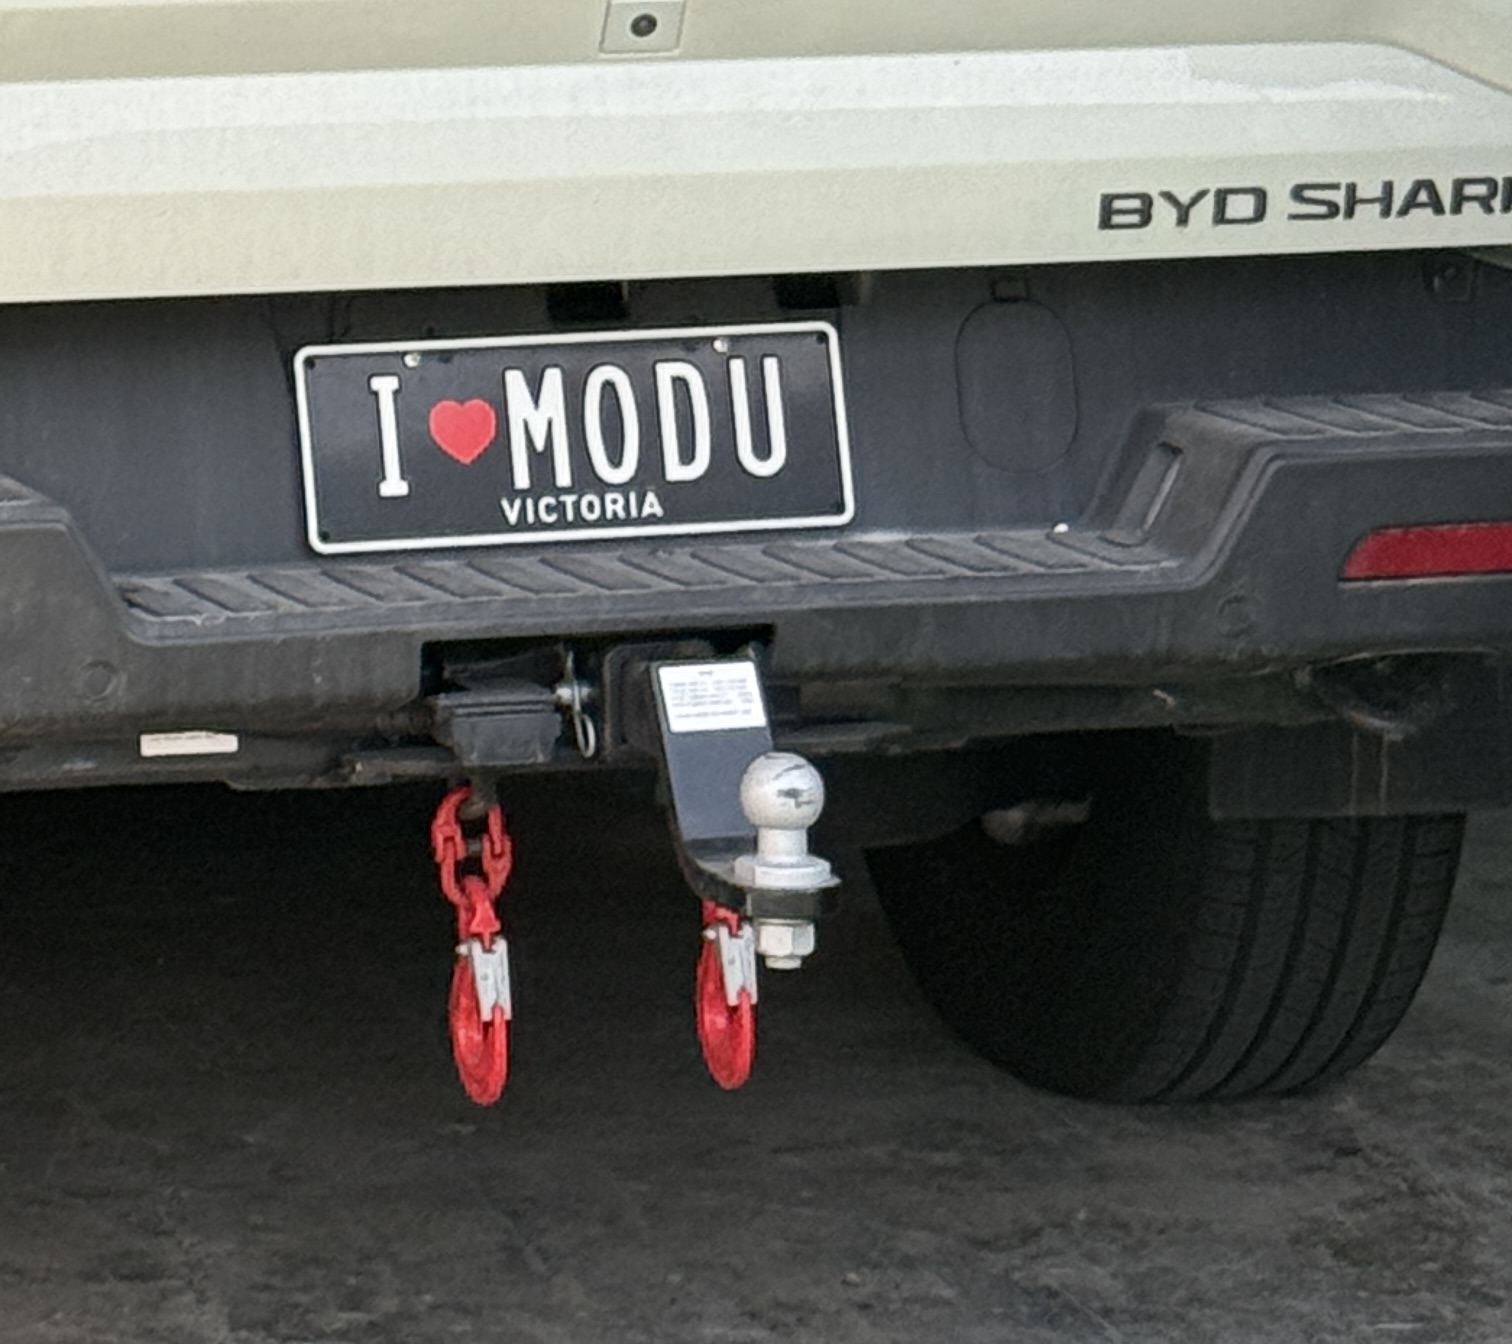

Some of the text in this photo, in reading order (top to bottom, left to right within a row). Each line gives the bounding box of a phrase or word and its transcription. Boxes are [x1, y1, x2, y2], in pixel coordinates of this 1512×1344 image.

[1097, 176, 1512, 230] BYD SHAR
[369, 356, 787, 497] I MODU
[500, 490, 665, 526] VICTORIA
